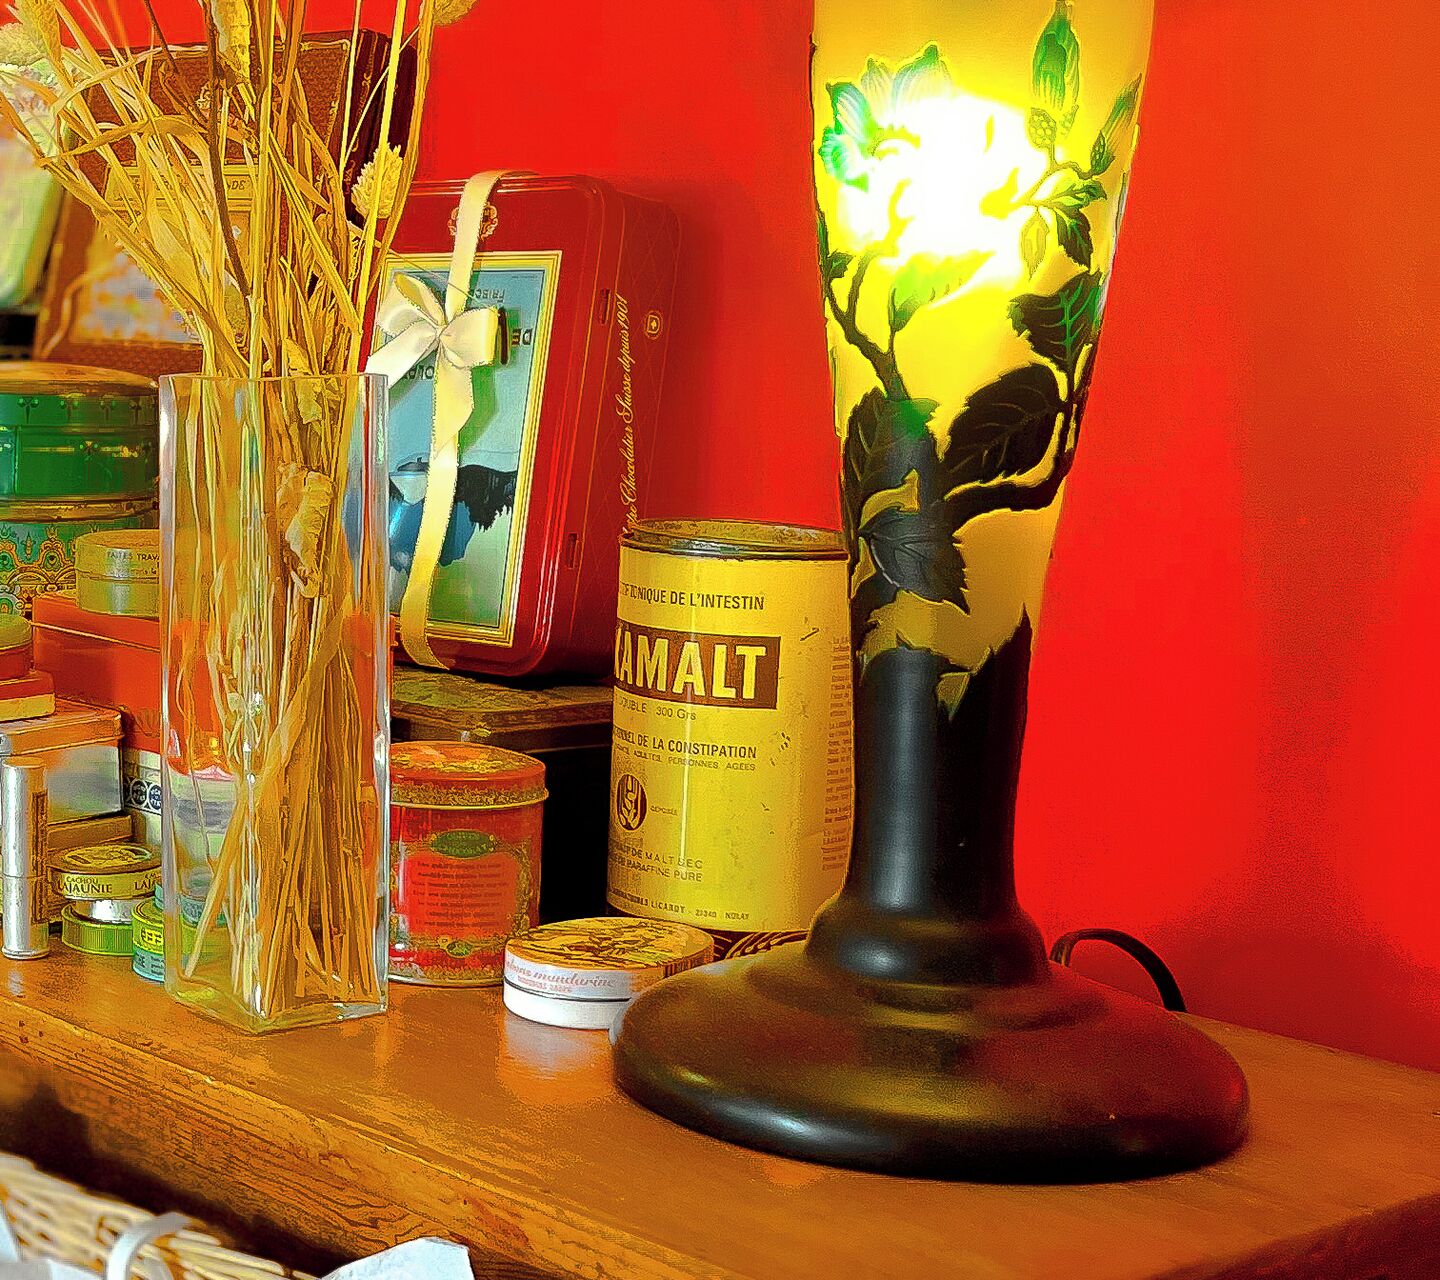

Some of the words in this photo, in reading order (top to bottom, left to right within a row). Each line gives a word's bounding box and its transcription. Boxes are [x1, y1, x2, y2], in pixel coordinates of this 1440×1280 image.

[615, 293, 630, 330] 1901
[617, 329, 636, 373] depuis
[614, 373, 634, 424] Suisse
[619, 424, 637, 507] Chocolatier
[670, 590, 686, 606] DE
[689, 592, 766, 611] L'INTESTIN
[656, 705, 673, 720] 300
[676, 707, 697, 722] Grs
[652, 736, 665, 750] LA
[668, 739, 758, 760] CONSTIPATION
[66, 876, 99, 884] CACHOU
[674, 869, 703, 883] PURE
[58, 882, 113, 895] LAJAUNIE
